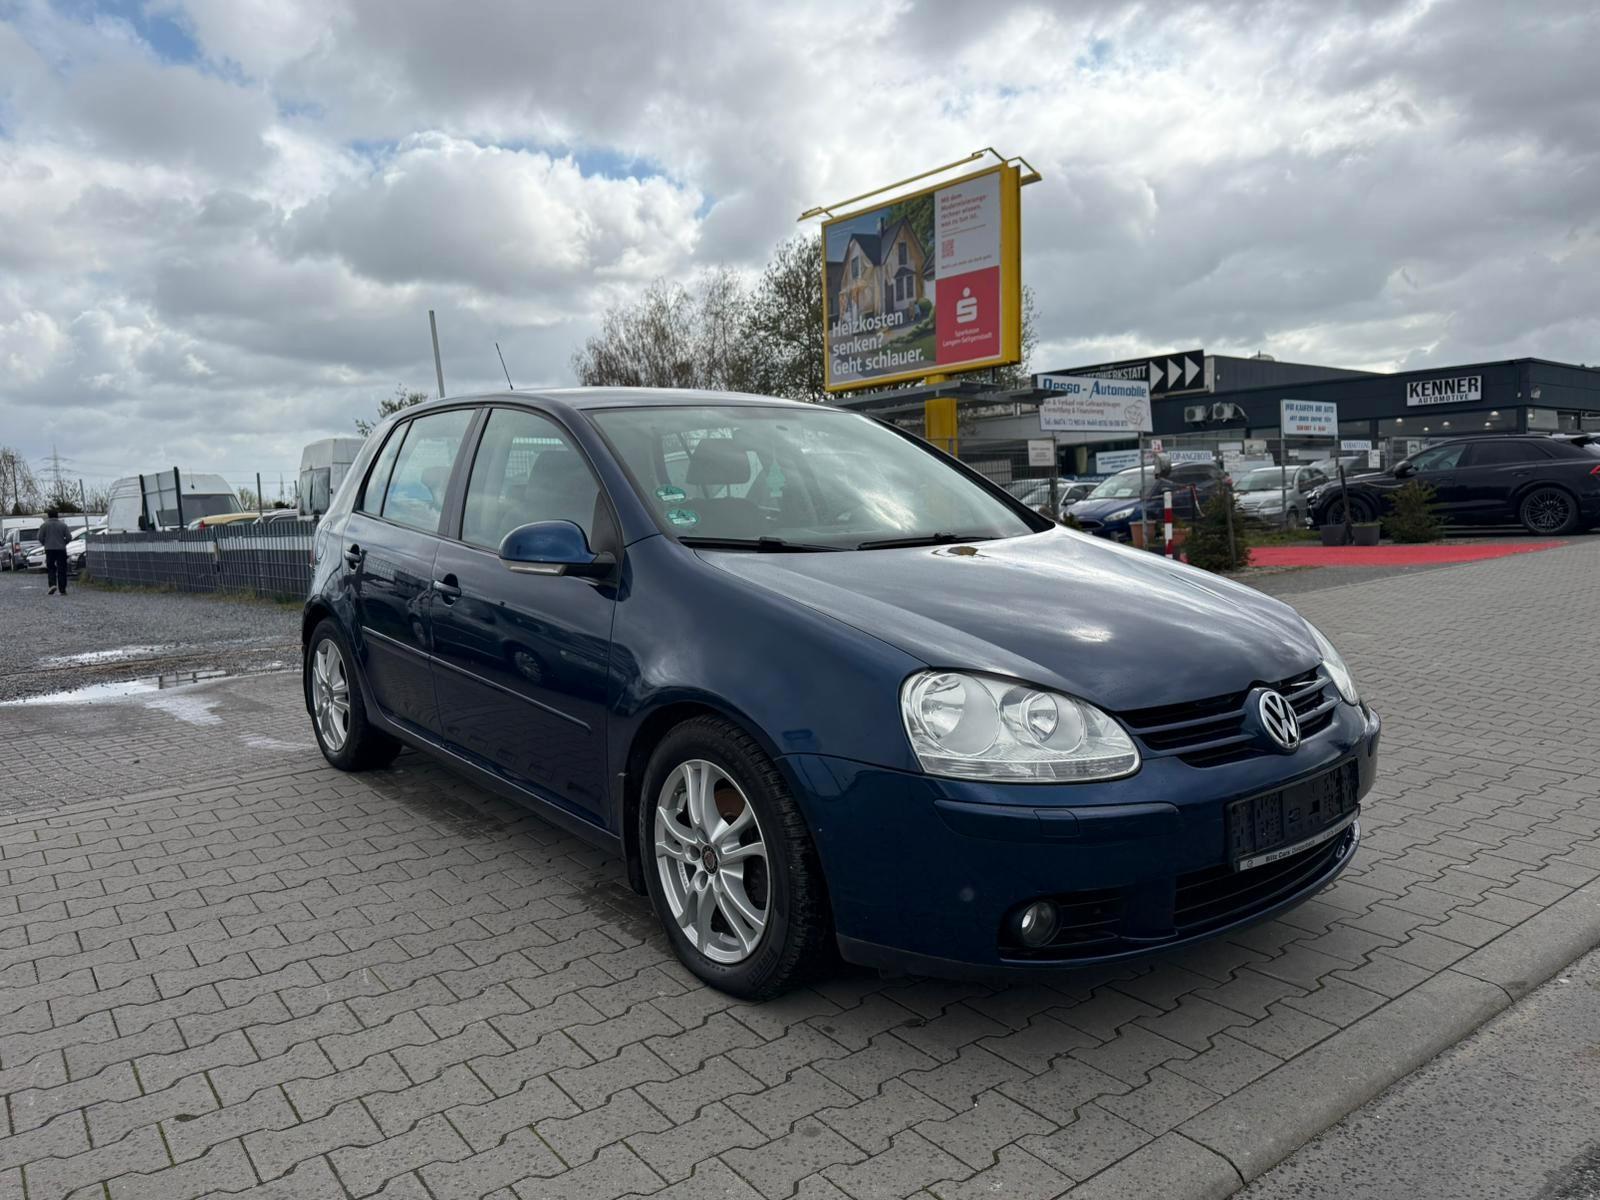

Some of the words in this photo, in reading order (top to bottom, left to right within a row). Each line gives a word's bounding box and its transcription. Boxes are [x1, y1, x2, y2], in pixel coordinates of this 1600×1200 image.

[832, 311, 904, 337] Heizkosten
[832, 332, 884, 356] senken?
[832, 356, 863, 376] Geht
[865, 348, 925, 371] schlauer.
[1089, 380, 1147, 399] Automobile
[1409, 377, 1479, 398] KENNER
[1296, 403, 1314, 412] KAUFEN
[1418, 393, 1469, 404] AUTOMOTIVE
